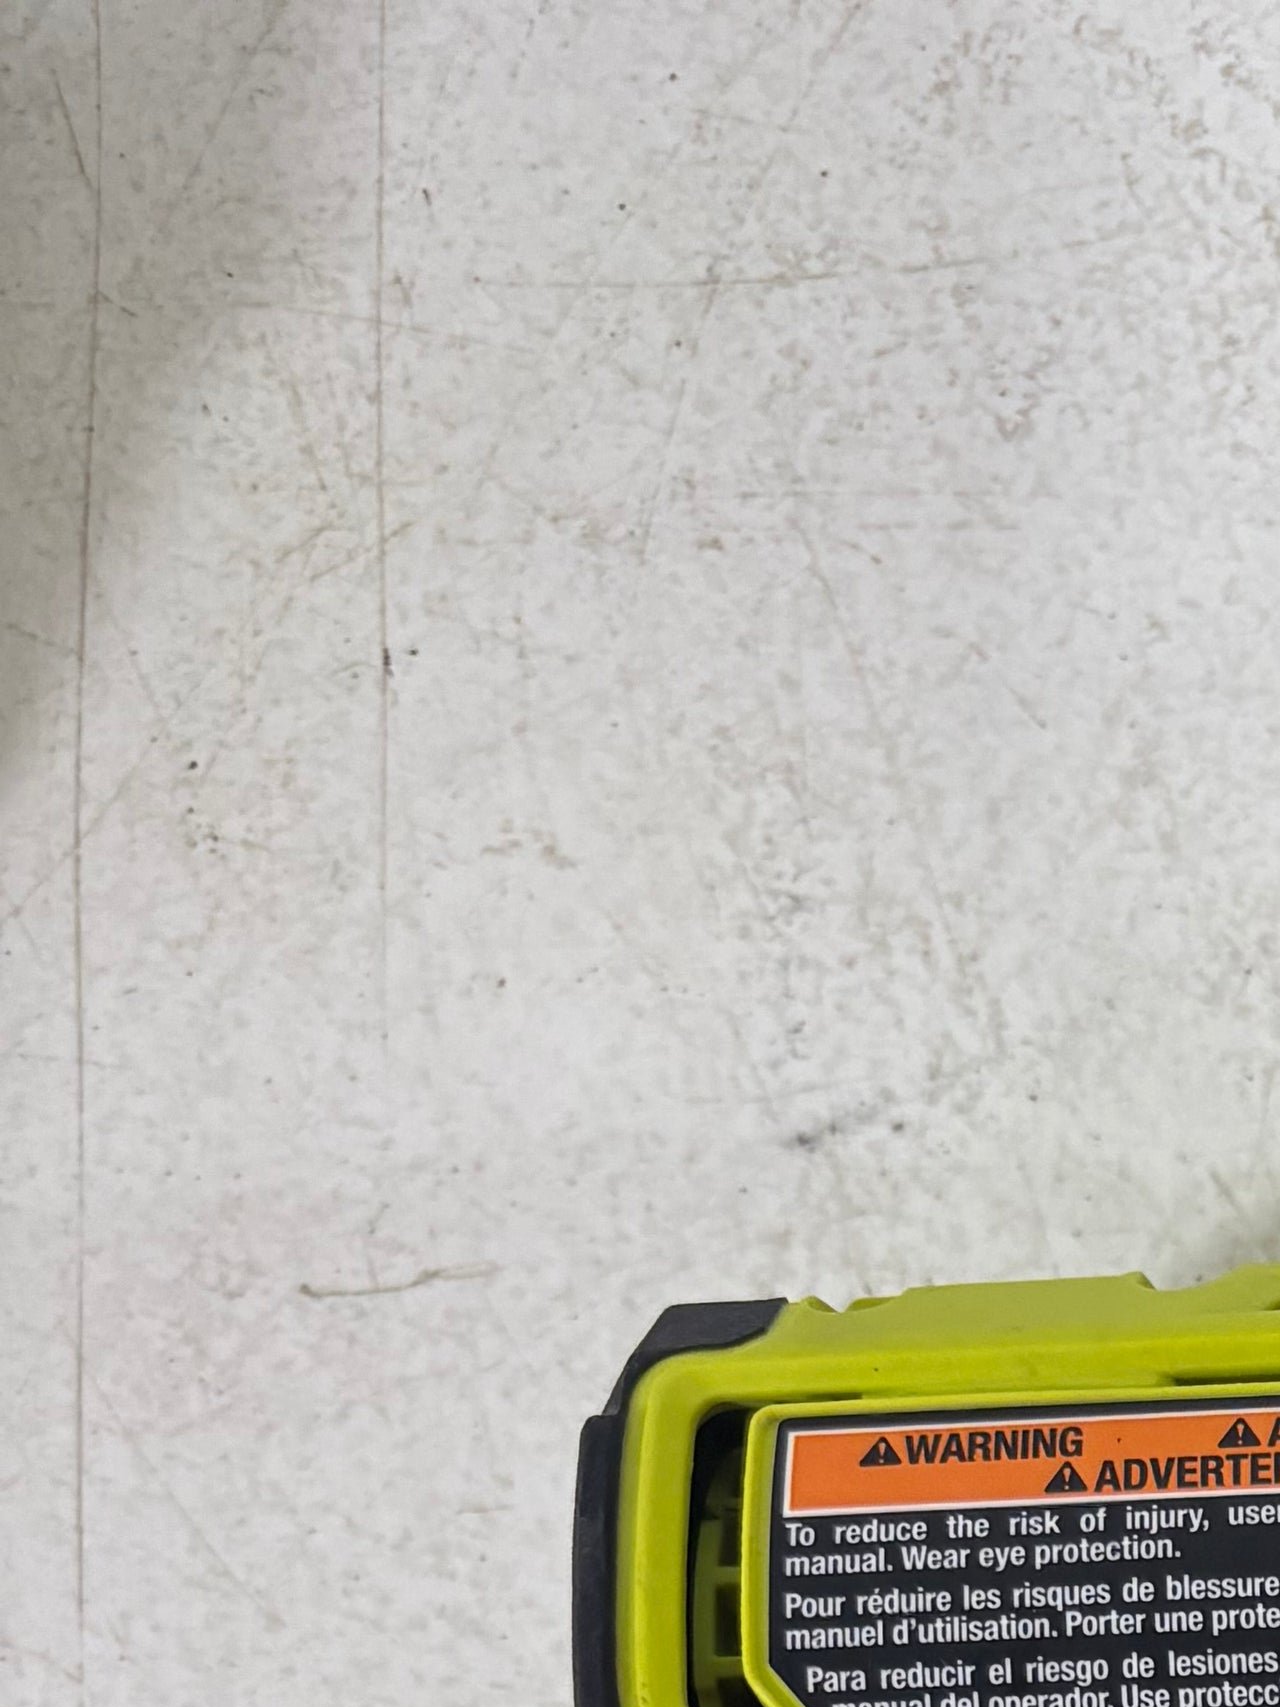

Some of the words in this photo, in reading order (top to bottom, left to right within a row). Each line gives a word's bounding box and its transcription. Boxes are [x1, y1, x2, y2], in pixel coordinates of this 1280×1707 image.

[904, 1426, 1084, 1464] WARNING
[784, 1522, 816, 1547] To
[834, 1518, 928, 1545] reduce
[945, 1513, 990, 1539] the
[1008, 1509, 1061, 1536] risk
[1079, 1506, 1107, 1533] of
[1125, 1504, 1210, 1535] injury,
[784, 1547, 894, 1577] manual.
[900, 1544, 971, 1571] Wear
[978, 1545, 1026, 1572] eye
[1034, 1534, 1182, 1570] protection.
[784, 1592, 847, 1619] Pour
[856, 1586, 952, 1615] réduire
[962, 1584, 1002, 1611] les
[1012, 1581, 1112, 1612] risques
[1122, 1576, 1155, 1603] de
[785, 1619, 884, 1650] manuel
[1065, 1609, 1147, 1637] Porter
[1154, 1610, 1204, 1633] une
[806, 1665, 867, 1694] Para
[880, 1659, 976, 1690] reducir
[988, 1657, 1012, 1685] el
[1025, 1655, 1109, 1687] riesgo
[1122, 1651, 1155, 1679] de
